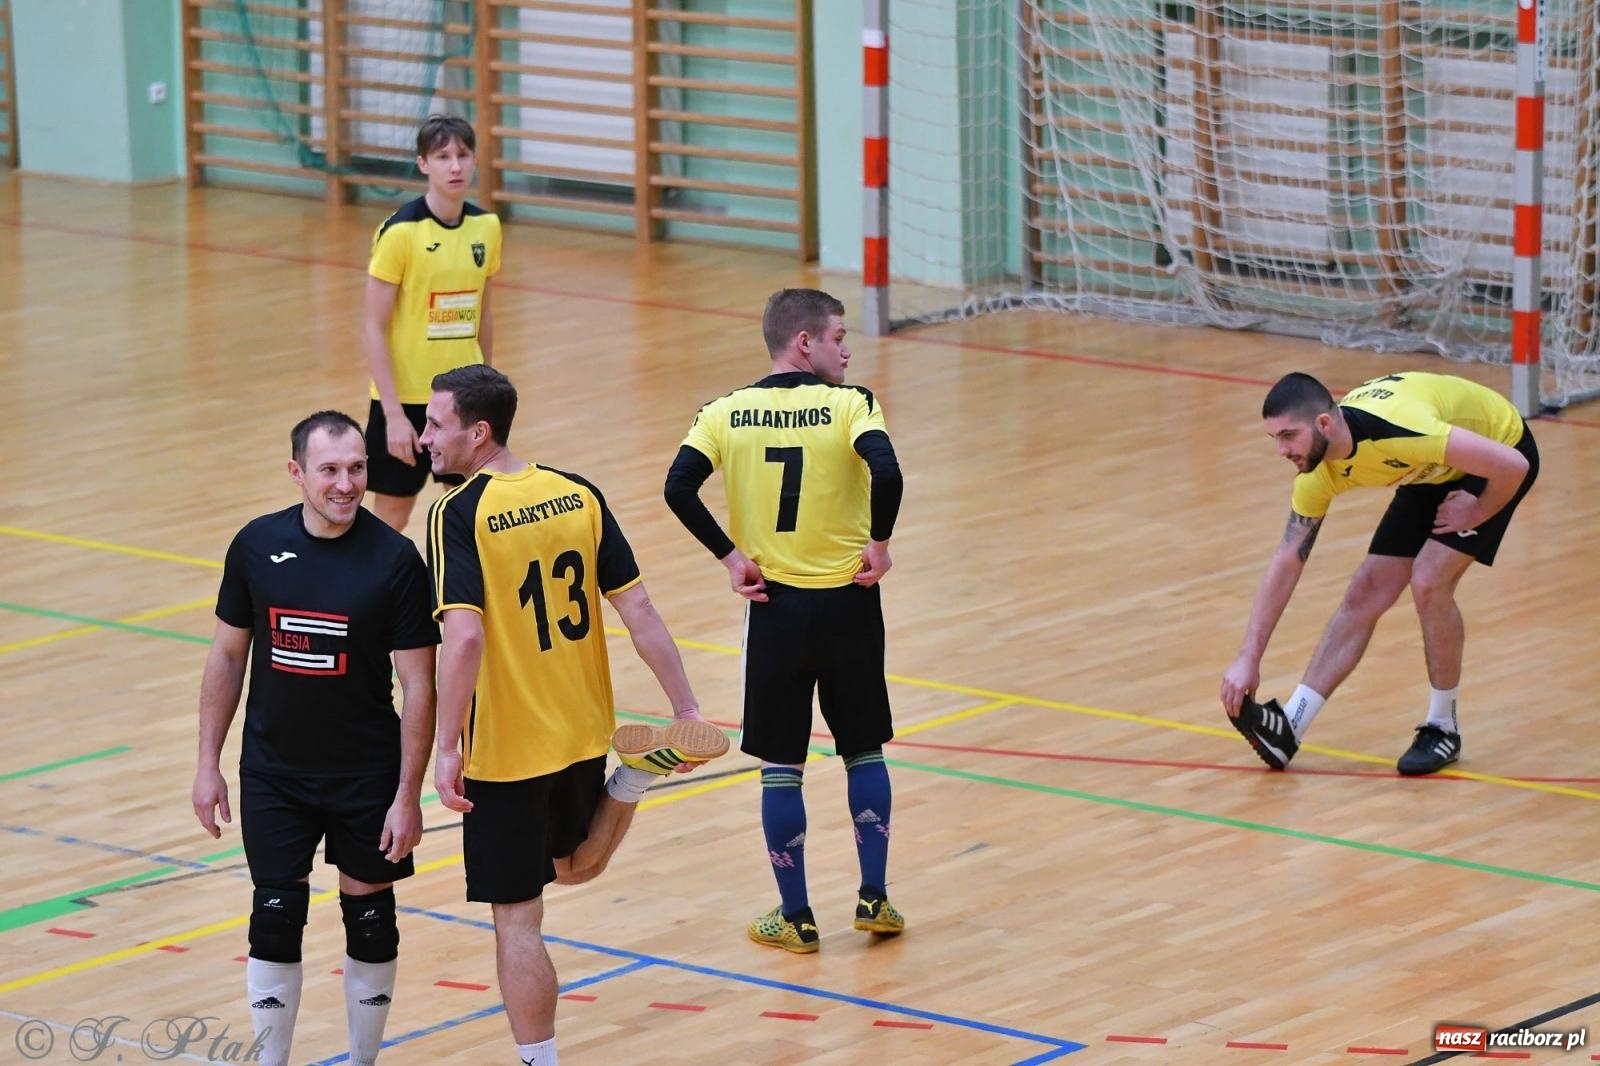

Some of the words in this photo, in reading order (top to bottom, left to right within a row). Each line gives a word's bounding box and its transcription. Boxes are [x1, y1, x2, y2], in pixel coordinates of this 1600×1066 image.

[730, 406, 832, 429] GALAKTIKOS
[765, 446, 804, 532] 7
[487, 493, 584, 534] GALAKTIKOS
[518, 550, 590, 652] 13
[271, 630, 311, 651] SILESIA
